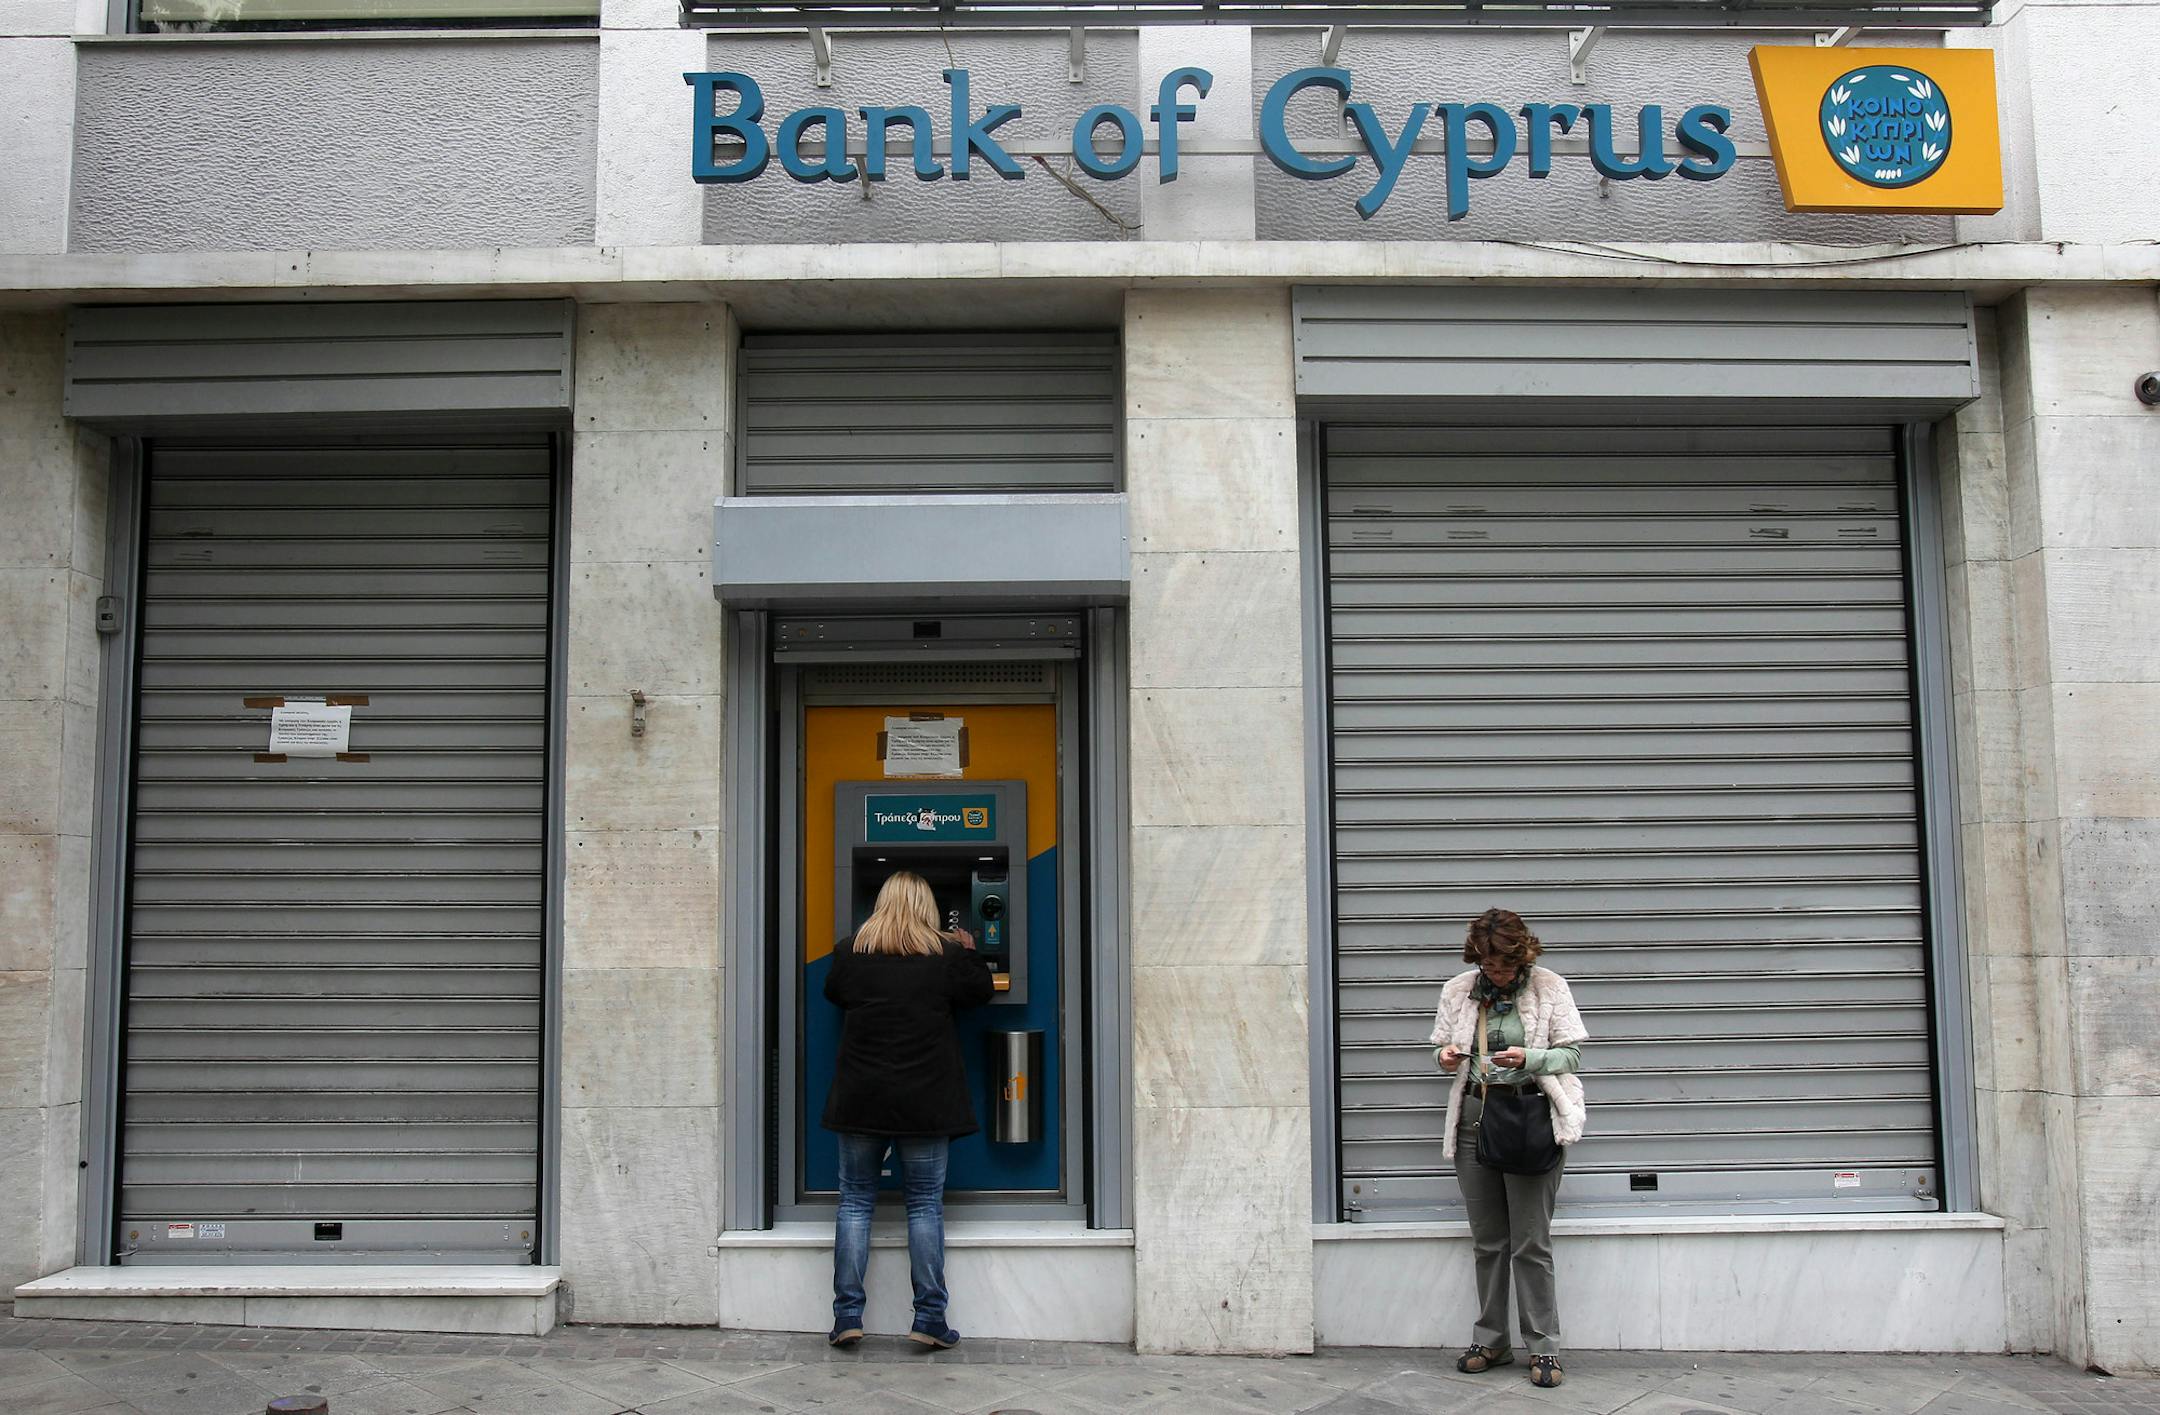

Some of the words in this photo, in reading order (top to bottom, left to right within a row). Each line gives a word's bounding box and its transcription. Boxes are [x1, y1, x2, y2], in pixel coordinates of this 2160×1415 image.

[1849, 97, 1925, 121] ΚΟΙΝΟ
[1851, 118, 1924, 143] ΚΥΠΡΙ
[683, 69, 1025, 184] Bank
[1072, 66, 1213, 185] of
[1259, 66, 1736, 221] Cyprus
[874, 812, 918, 825] Τράπεζα
[920, 812, 961, 826] πρου
